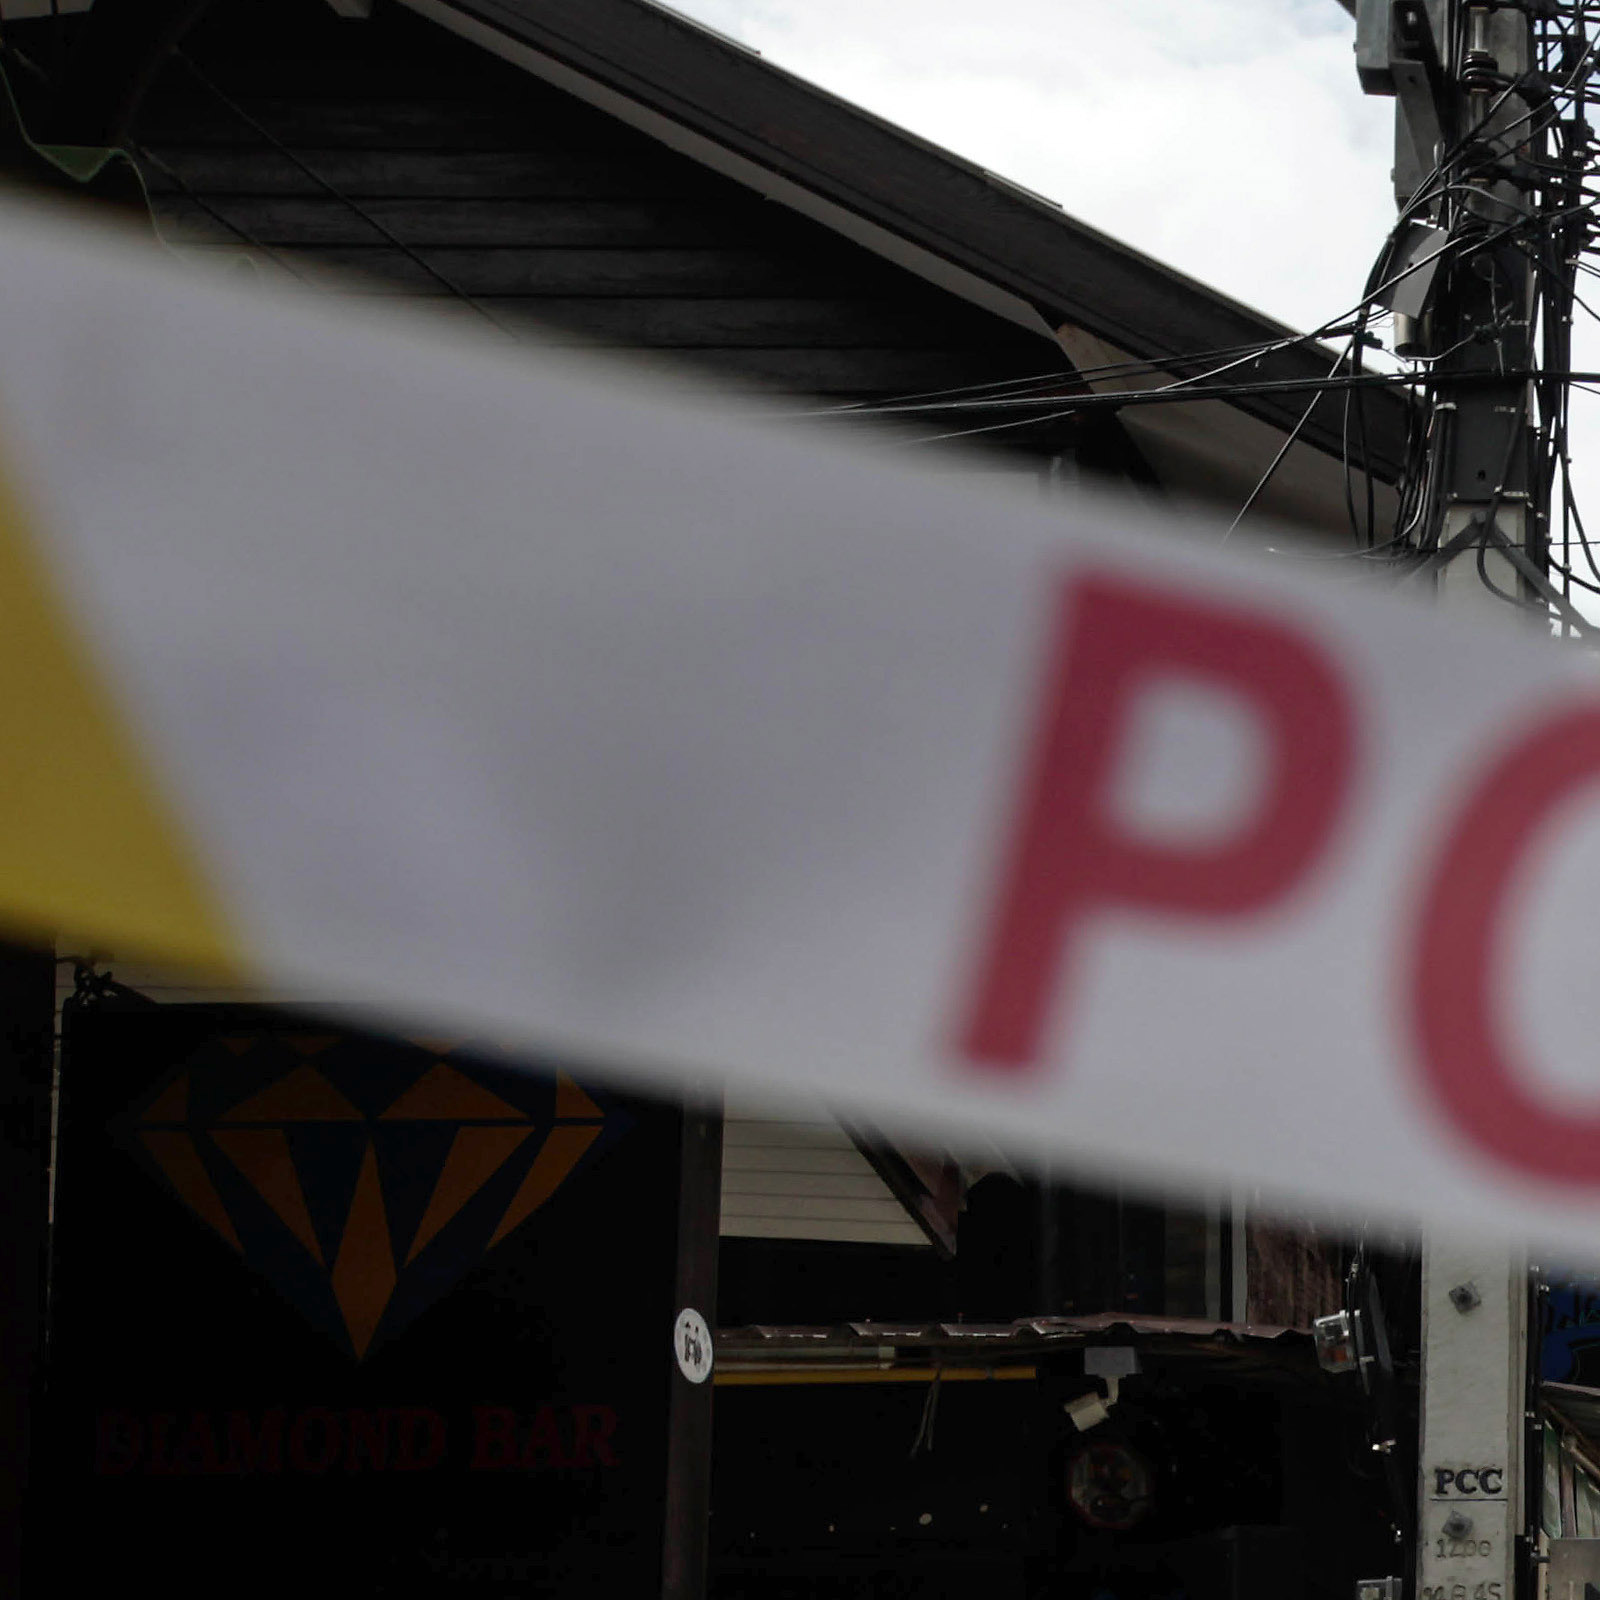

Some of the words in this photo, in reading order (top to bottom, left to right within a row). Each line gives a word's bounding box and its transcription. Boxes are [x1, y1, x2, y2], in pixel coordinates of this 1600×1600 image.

[97, 1404, 447, 1476] DIAMOND
[469, 1403, 621, 1471] BAR
[1434, 1468, 1503, 1495] PCC
